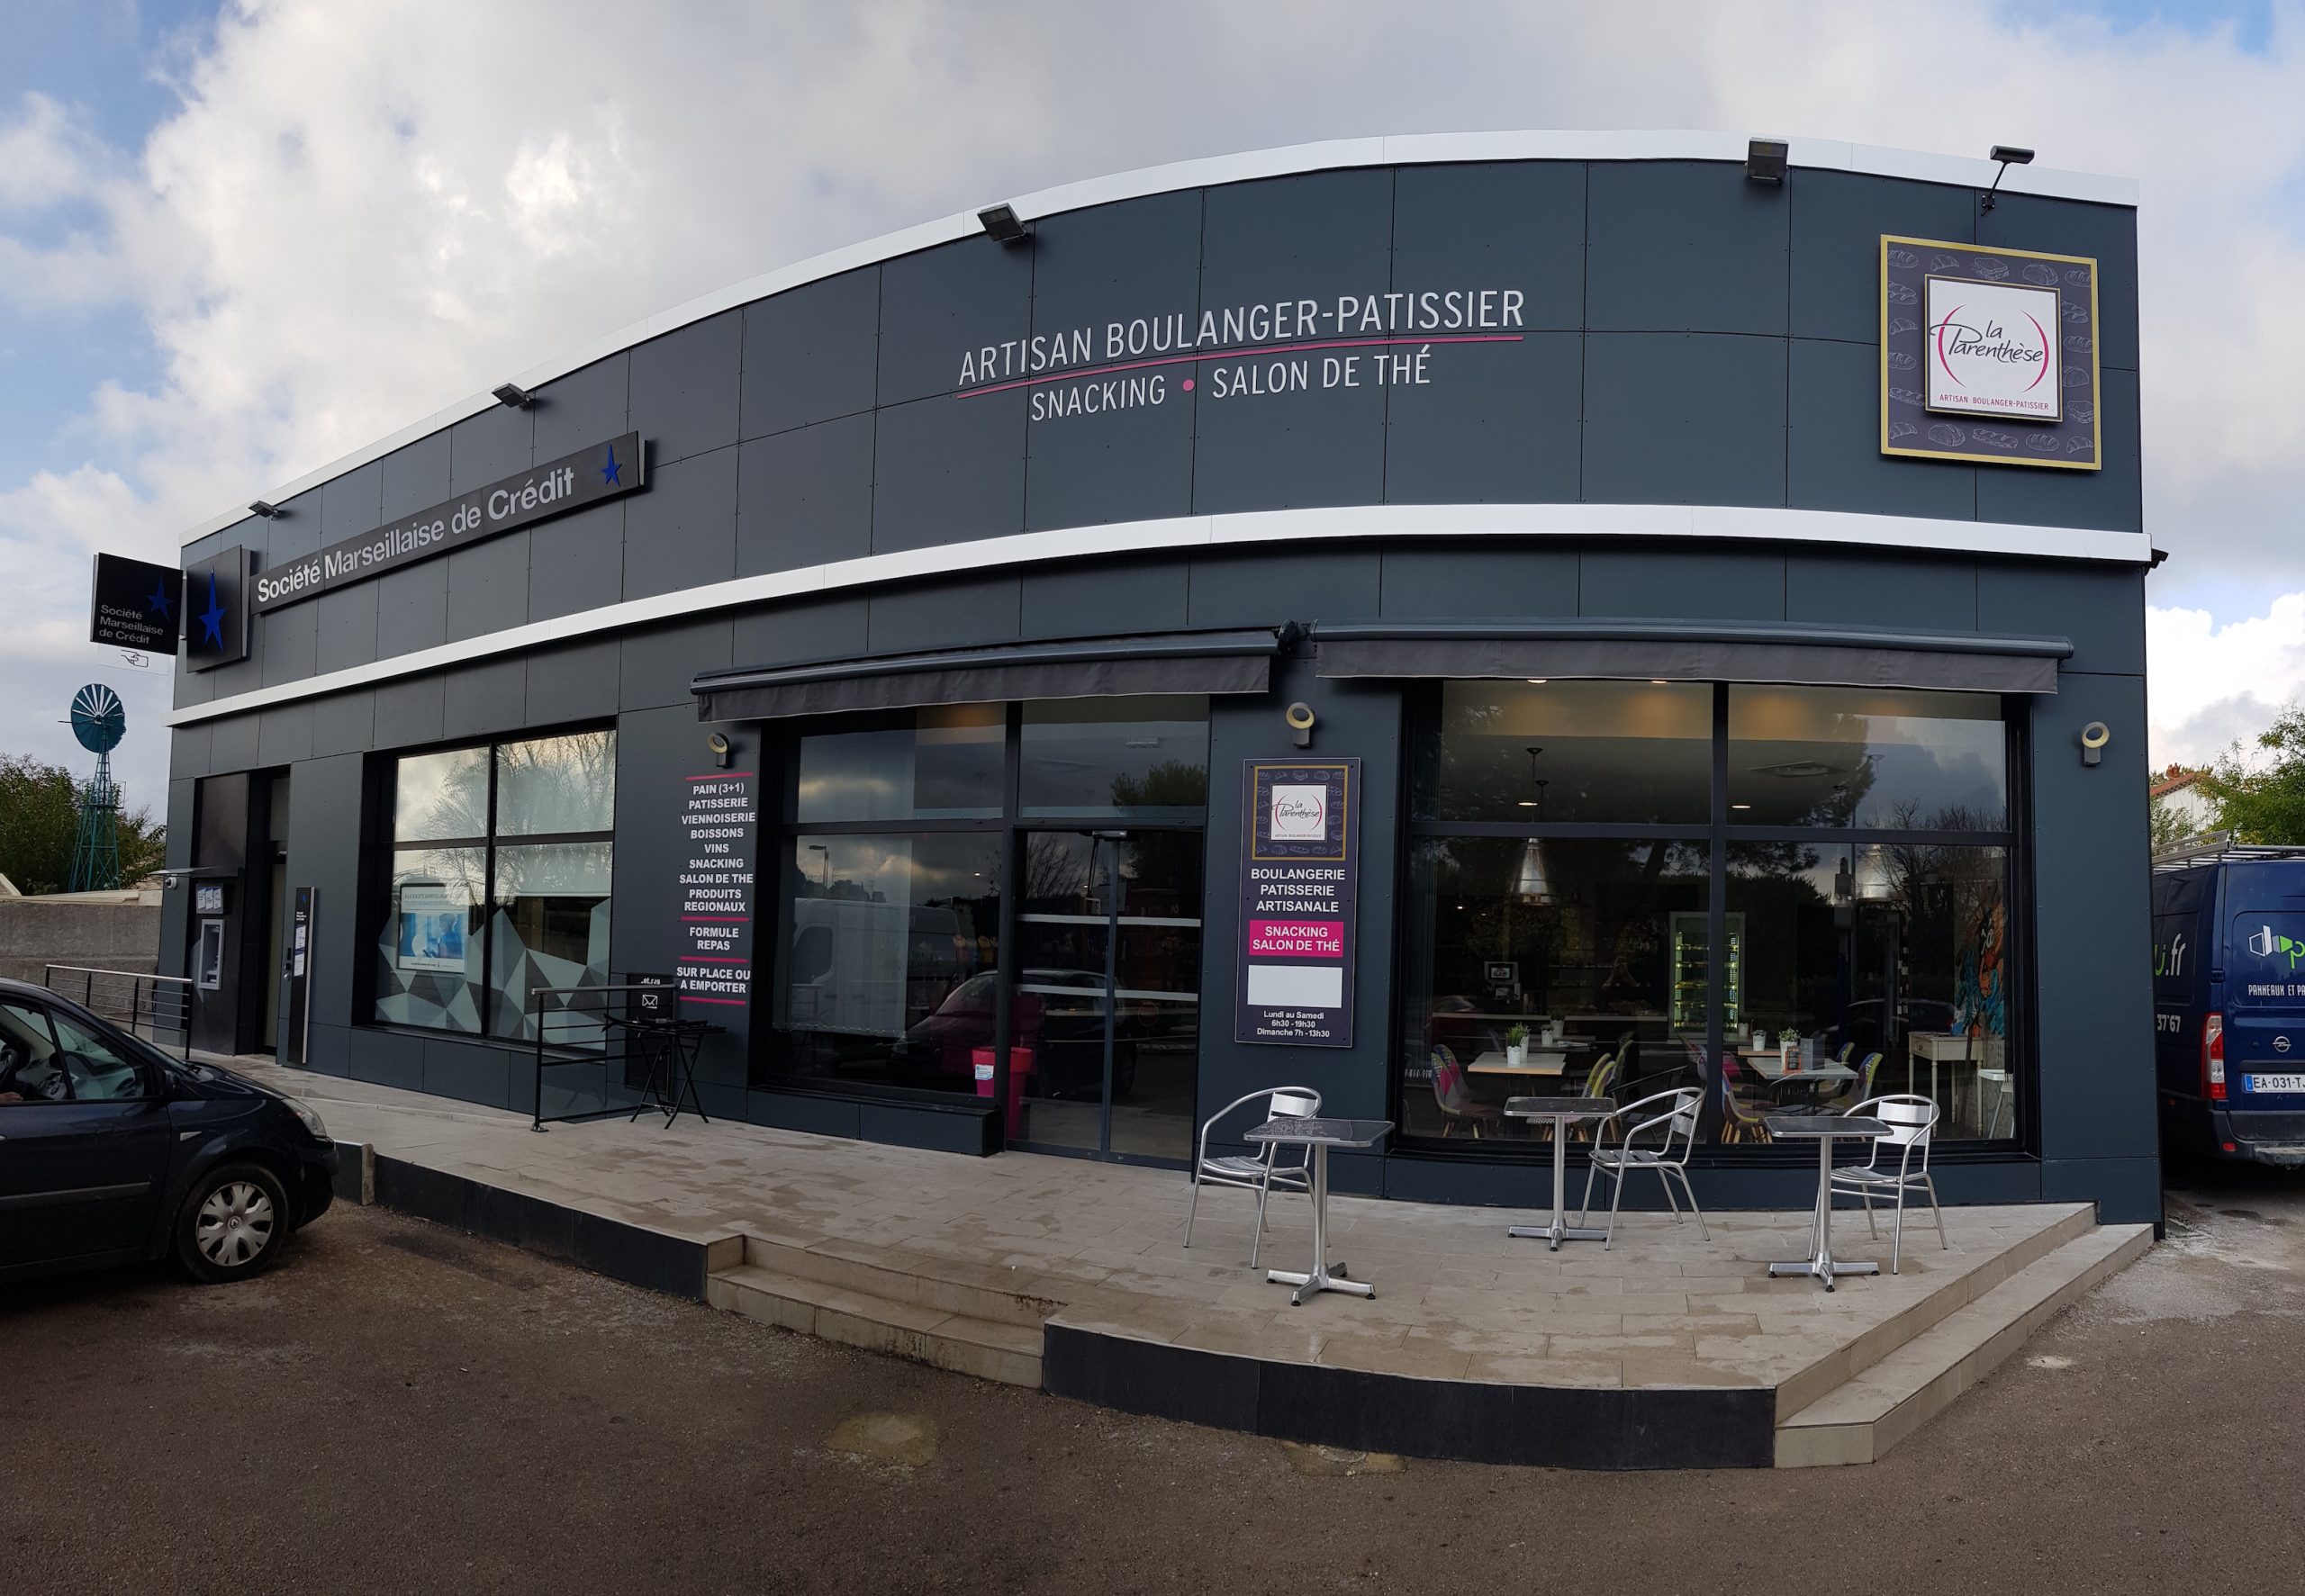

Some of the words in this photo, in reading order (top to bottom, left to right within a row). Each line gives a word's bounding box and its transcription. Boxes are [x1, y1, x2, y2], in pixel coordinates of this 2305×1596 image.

[1985, 320, 2002, 339] la
[958, 327, 1093, 386] ARTISAN
[1107, 289, 1525, 358] BOULANGER-PATISSIER
[1930, 323, 2044, 363] Parenthèse
[1031, 374, 1167, 422] SNACKING
[1212, 359, 1309, 400] SALON
[1323, 356, 1360, 389] DE
[1374, 344, 1432, 386] THÉ
[1939, 394, 1968, 403] ARTISAN
[1972, 396, 2049, 410] BOULANGER-PATISSIER
[257, 563, 321, 604] Société
[324, 518, 445, 579] Marseillaise
[451, 502, 482, 536] de
[487, 466, 574, 522] Crédit
[101, 604, 143, 620] Société
[100, 616, 164, 636] Marseillaise
[99, 628, 114, 638] de
[115, 630, 150, 645] Crédit
[692, 783, 718, 796] PAIN
[719, 781, 745, 796] (3+1)
[688, 797, 748, 810] PATISSERIE
[681, 812, 756, 825] VIENNOISERIE
[690, 827, 745, 840] BOISSONS
[704, 843, 730, 854] VINS
[689, 858, 745, 870] SNACKING
[679, 873, 714, 884] SALON
[715, 873, 730, 884] DE
[731, 873, 754, 884] THE
[1251, 868, 1346, 881] BOULANGERIE
[689, 888, 742, 899] PRODUITS
[1261, 884, 1335, 897] PATISSERIE
[683, 901, 746, 912] REGIONAUX
[1256, 900, 1340, 913] ARTISANALE
[689, 926, 740, 939] FORMULE
[1264, 925, 1329, 938] SNACKING
[697, 940, 731, 951] REPAS
[1252, 939, 1294, 951] SALON
[1296, 940, 1313, 951] DE
[1315, 938, 1340, 952] THÉ
[676, 966, 698, 978] SUR
[699, 968, 734, 979] PLACE
[735, 969, 751, 981] OU
[680, 979, 689, 990] A
[689, 980, 746, 994] EMPORTER
[2247, 984, 2285, 996] PANNEAUX
[2288, 984, 2295, 996] ET
[1263, 1010, 1284, 1019] Lundi
[1296, 1011, 1324, 1020] Samedi
[1271, 1019, 1289, 1028] 6h30
[1257, 1028, 1293, 1037] Dimanche
[1294, 1029, 1304, 1037] 7h
